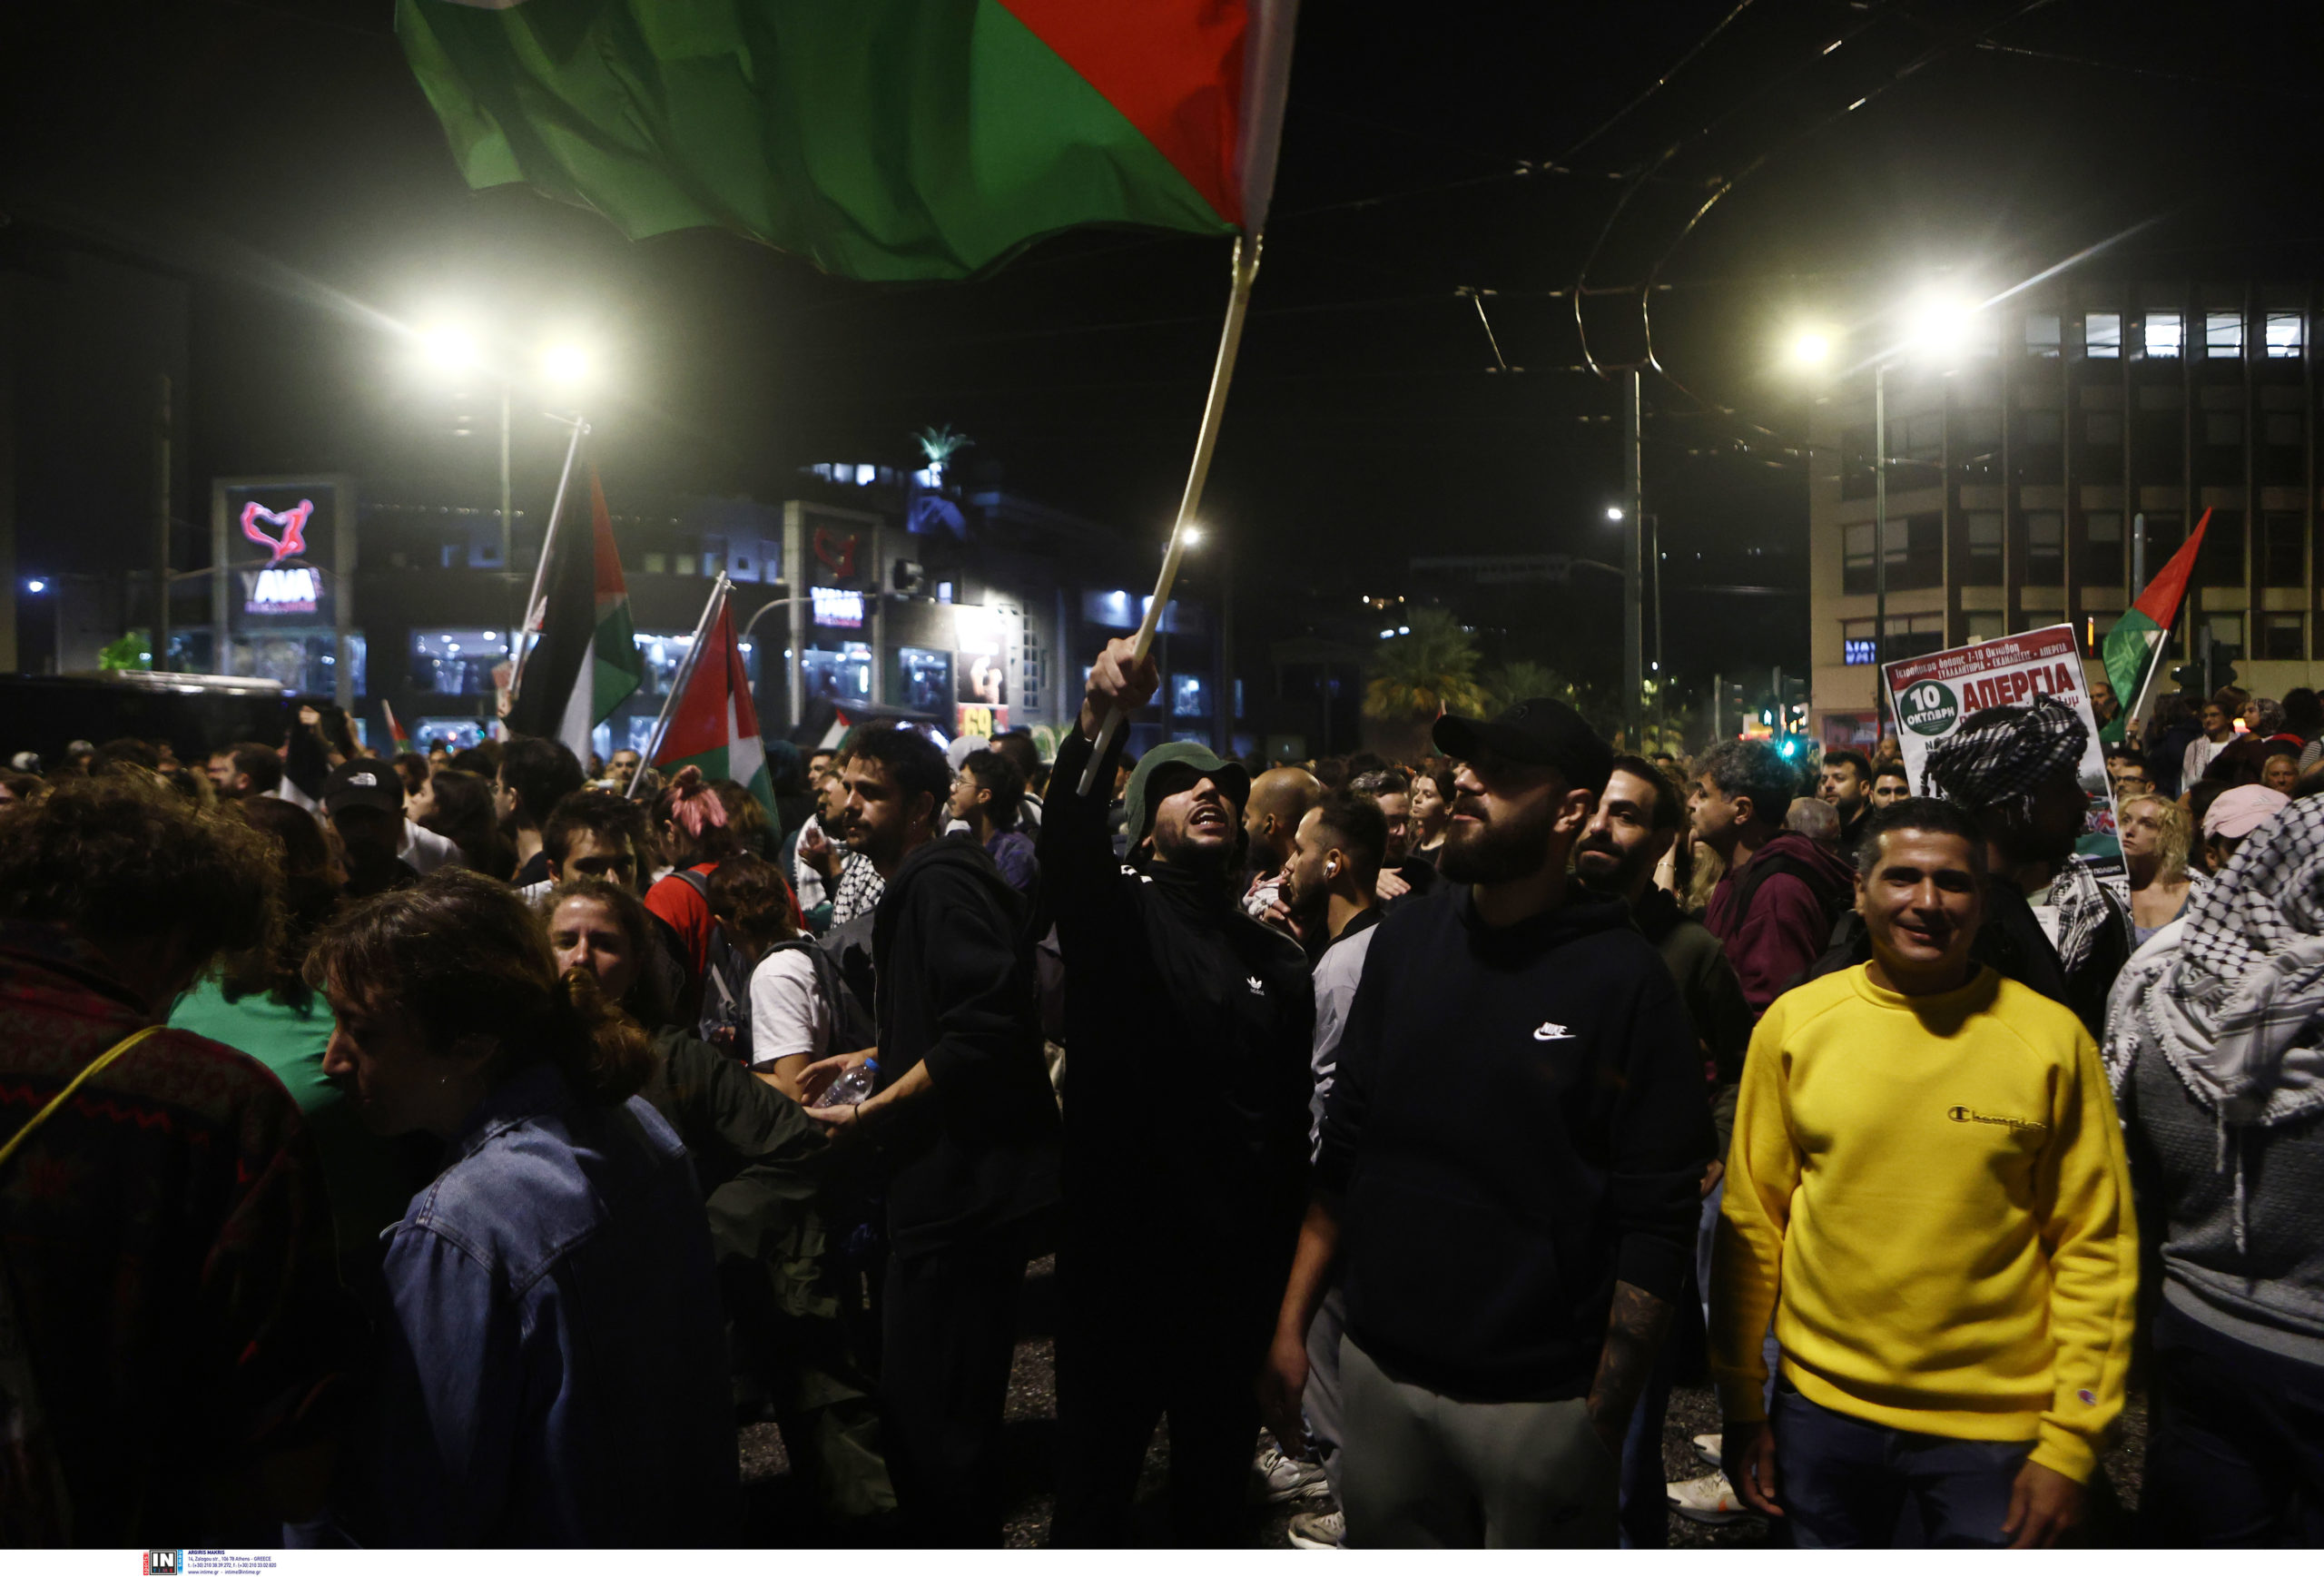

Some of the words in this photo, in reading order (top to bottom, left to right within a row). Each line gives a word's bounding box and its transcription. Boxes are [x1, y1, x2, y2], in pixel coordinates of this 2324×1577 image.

[2040, 643, 2067, 656] ΑΠΕΡΓΙΑ
[1910, 685, 1941, 711] 10
[1963, 662, 2075, 713] ΑΠΕΡΓΙΑ
[963, 706, 991, 740] 69
[1906, 705, 1955, 725] ΟΚΤΩΒΡΗ
[1540, 1021, 1568, 1036] NIKE
